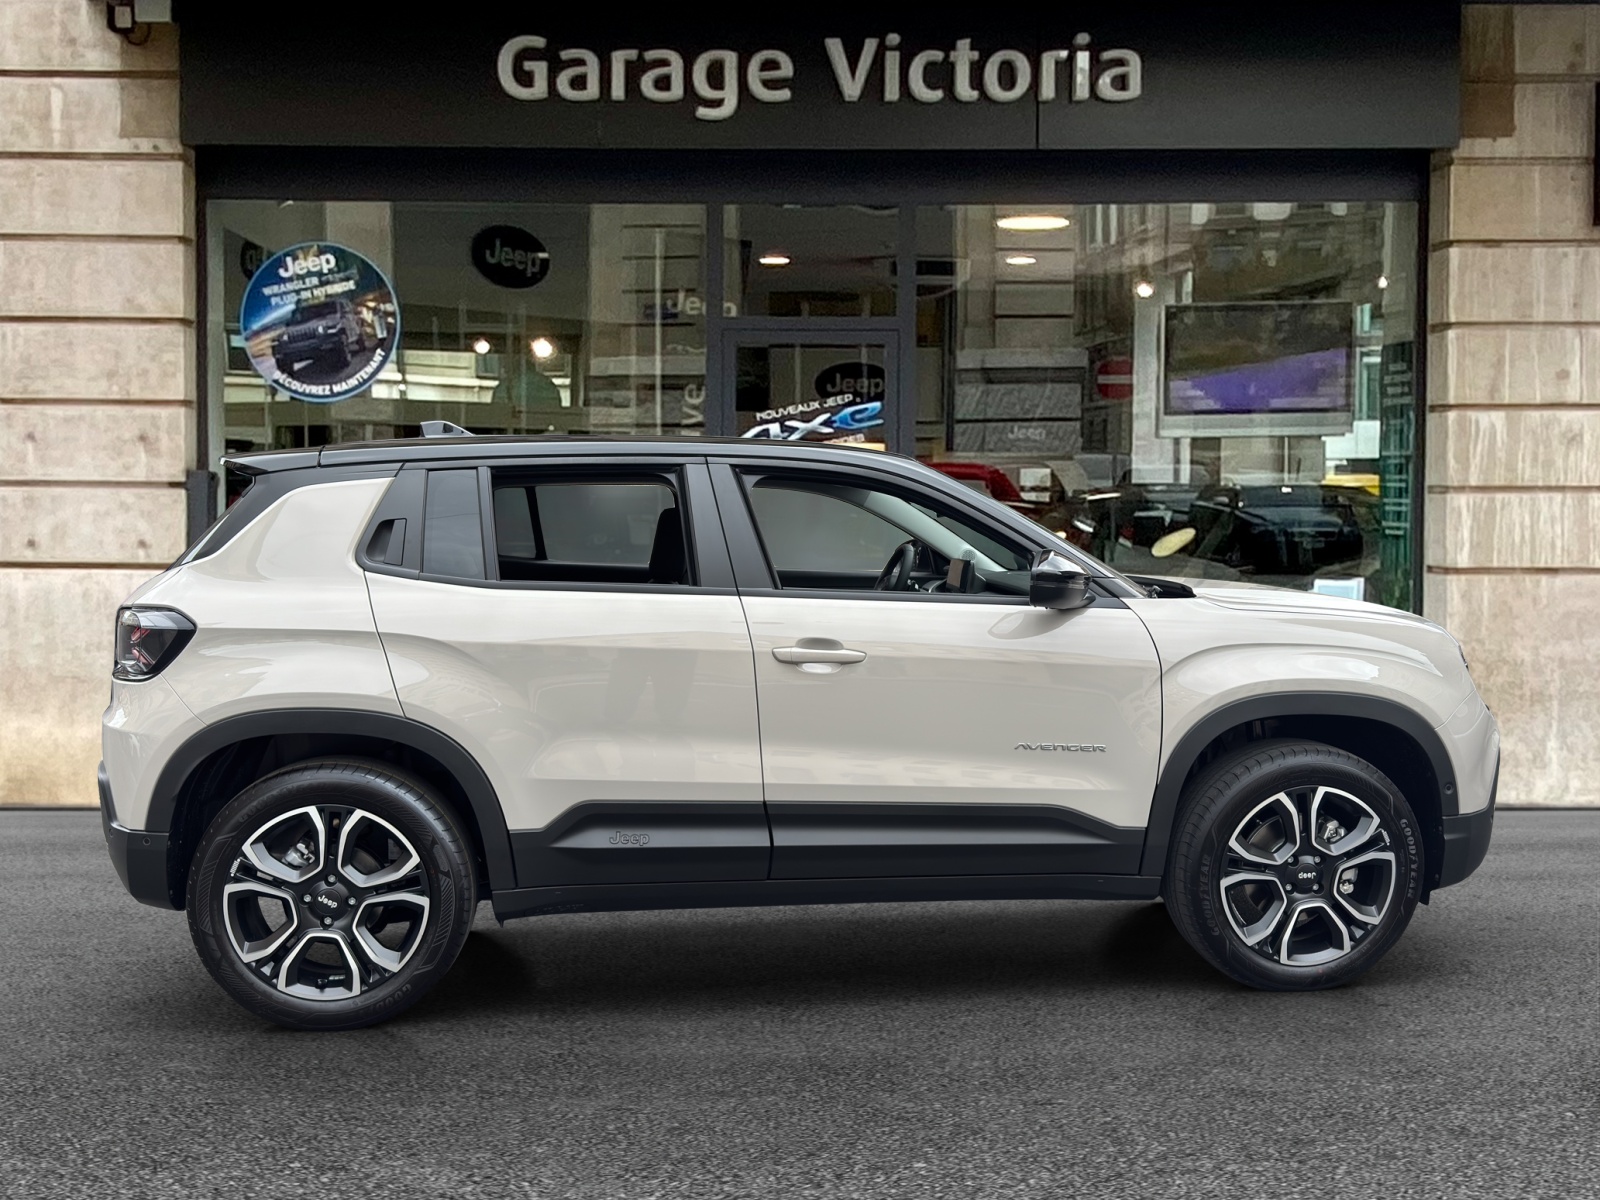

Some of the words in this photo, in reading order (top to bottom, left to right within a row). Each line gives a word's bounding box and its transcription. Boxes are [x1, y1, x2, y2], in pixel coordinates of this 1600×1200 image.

[497, 34, 794, 121] Garage
[824, 32, 1142, 102] Victoria
[278, 252, 337, 279] Jeep
[485, 238, 541, 277] Jeep
[262, 276, 320, 296] WRANGLER
[666, 288, 737, 318] Jep
[332, 348, 386, 393] MAINTENANT
[826, 372, 884, 397] Jeep
[756, 400, 821, 422] NOUVEAUX
[823, 393, 854, 409] JEEP
[1014, 742, 1107, 753] AVENGER
[609, 831, 650, 847] Jeep
[317, 894, 338, 909] Jeep
